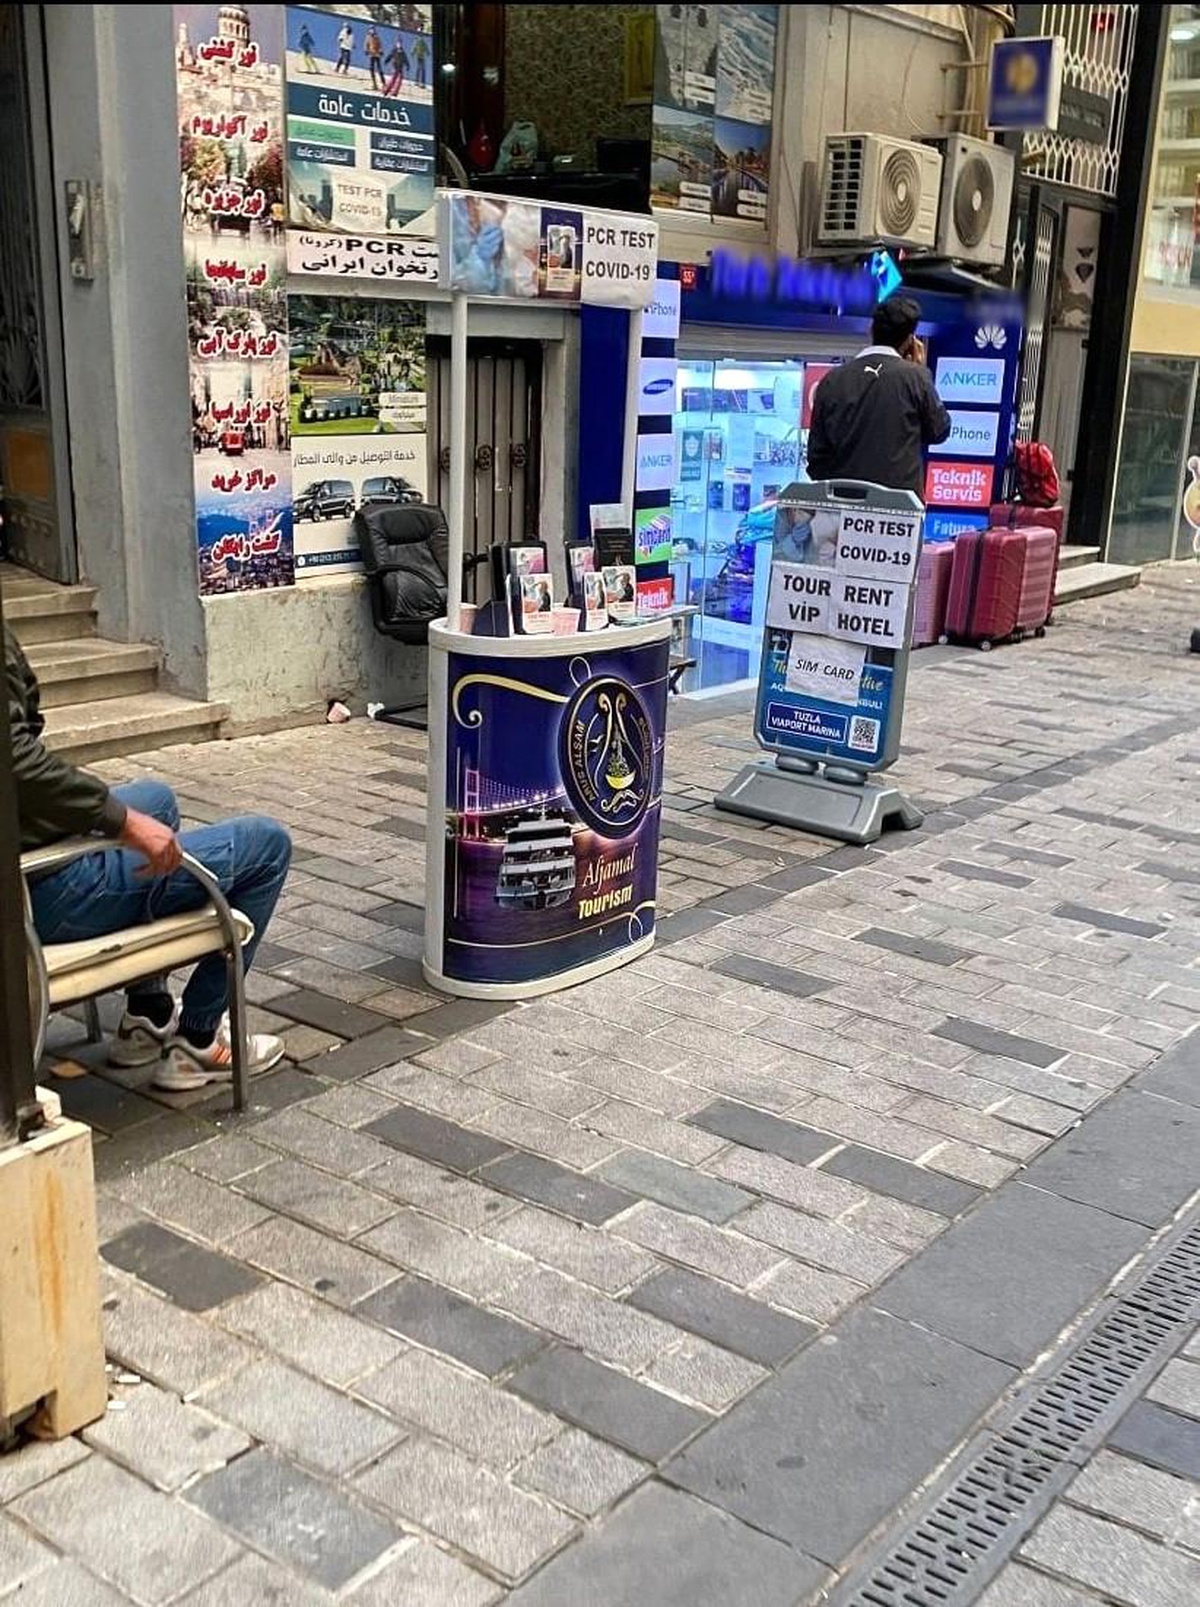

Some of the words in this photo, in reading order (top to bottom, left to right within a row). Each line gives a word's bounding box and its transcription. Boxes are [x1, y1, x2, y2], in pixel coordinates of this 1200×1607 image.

[318, 93, 354, 117] عامة
[361, 101, 411, 126] خدمات
[338, 183, 362, 197] TEST
[364, 187, 382, 199] PCR
[346, 238, 405, 256] PCR
[586, 226, 616, 245] PCR
[620, 230, 656, 250] TEST
[301, 252, 365, 274] ایرانی
[585, 261, 651, 281] COVID-19
[939, 372, 997, 387] ANKER
[951, 425, 991, 441] Phone
[639, 454, 673, 468] ANKER
[931, 468, 987, 487] Teknik
[931, 486, 982, 502] Servis
[843, 517, 874, 534] PCR
[878, 521, 915, 538] TEST
[840, 544, 912, 566] COVID-19
[783, 574, 831, 597] TOUR
[843, 585, 894, 608] RENT
[837, 612, 895, 637] HOTEL
[795, 659, 819, 673] SIM
[823, 665, 855, 680] CARD
[793, 710, 821, 724] TUZLA
[771, 717, 807, 732] VIAPORT
[808, 724, 841, 739] MARINA
[581, 842, 639, 895] Aljamal
[578, 883, 634, 920] Tourism
